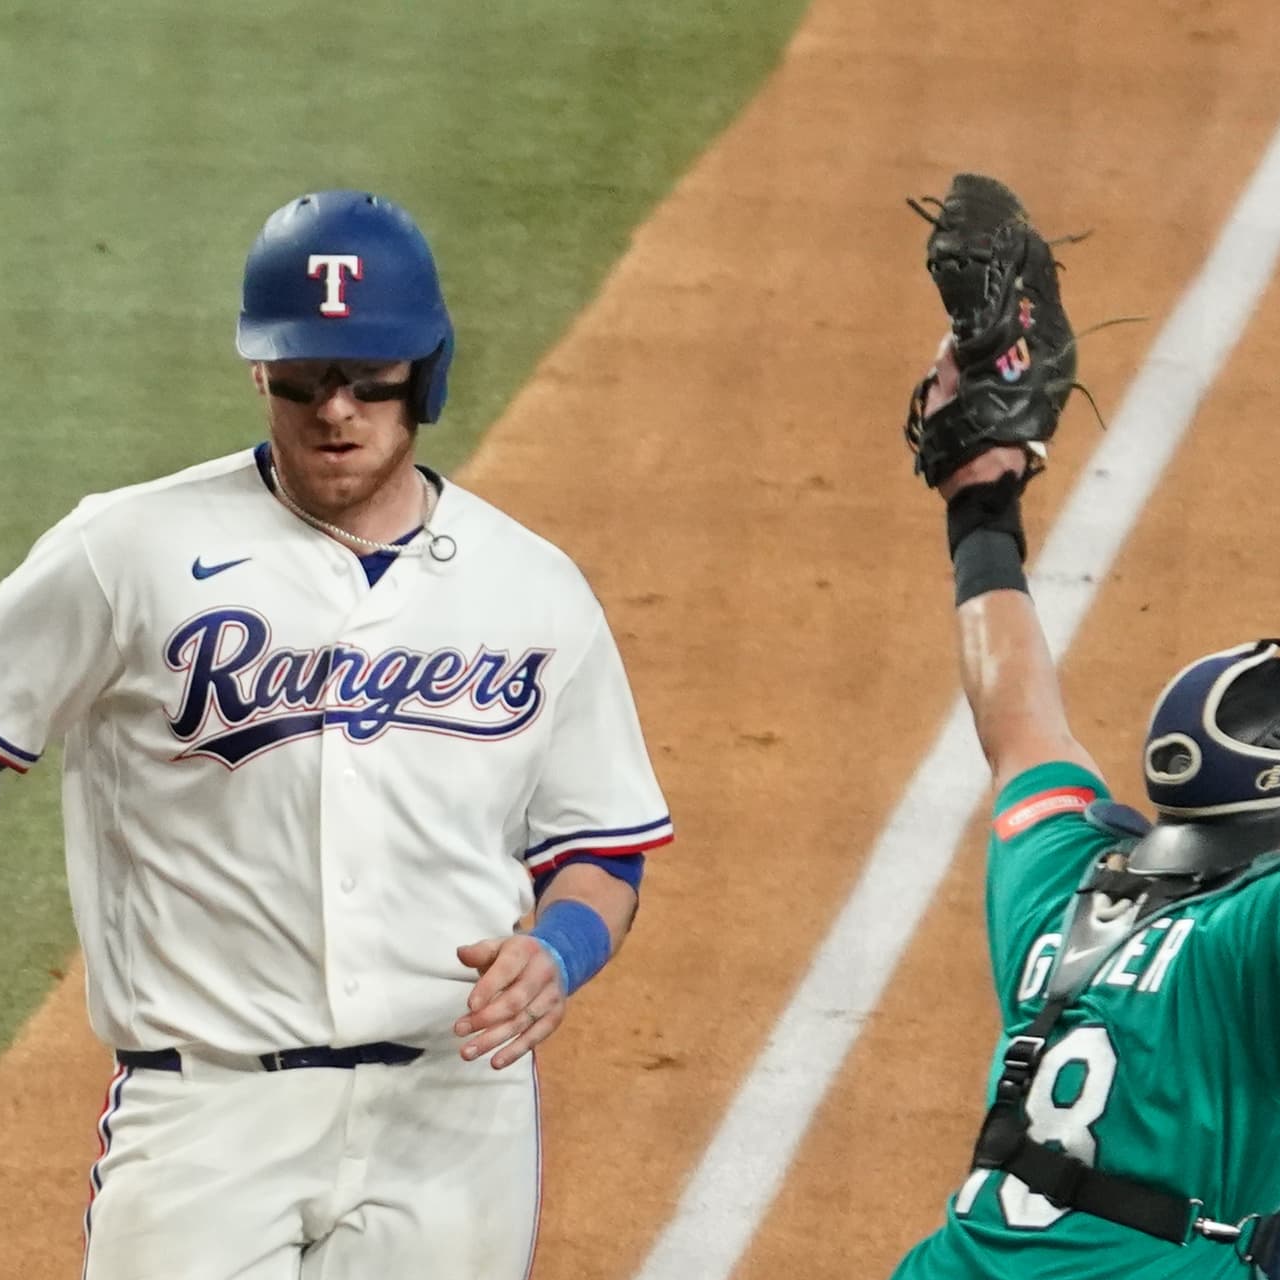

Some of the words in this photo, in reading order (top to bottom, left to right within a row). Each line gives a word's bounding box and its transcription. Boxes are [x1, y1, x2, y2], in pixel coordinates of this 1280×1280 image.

[308, 255, 363, 318] T
[163, 605, 556, 746] Rangers
[1017, 917, 1196, 1001] GER
